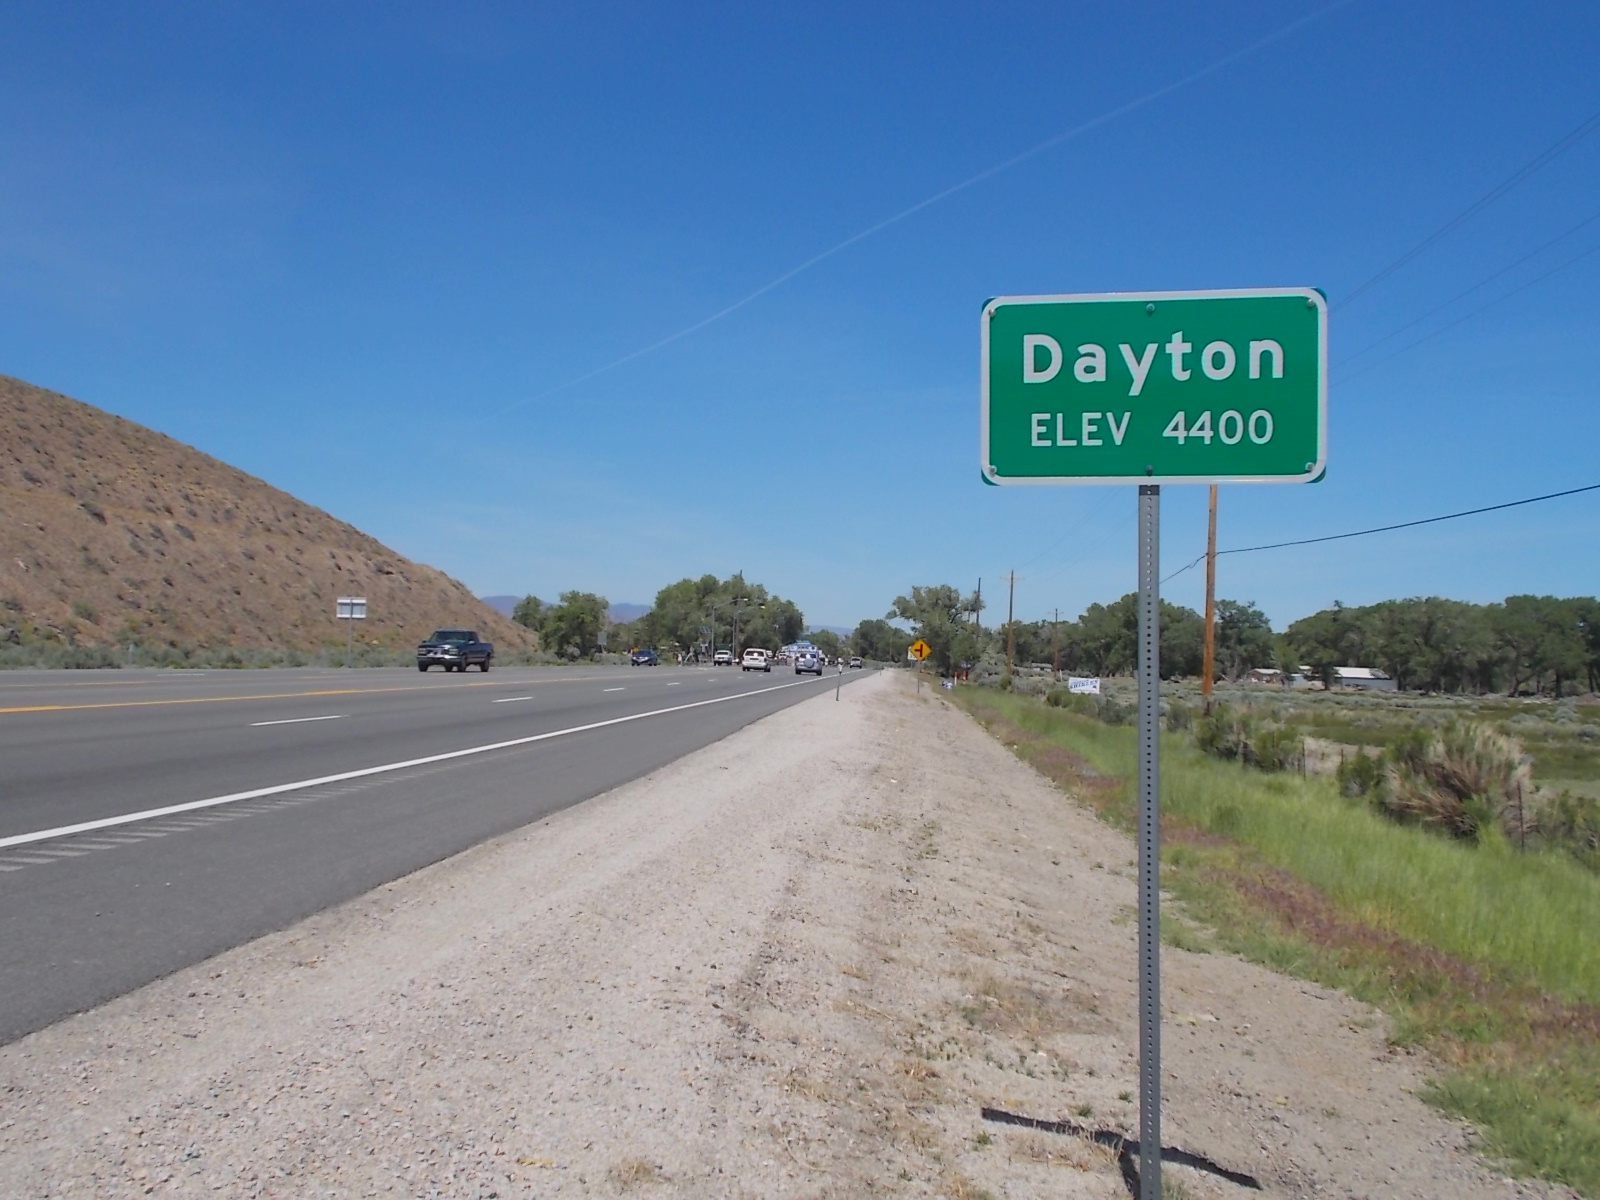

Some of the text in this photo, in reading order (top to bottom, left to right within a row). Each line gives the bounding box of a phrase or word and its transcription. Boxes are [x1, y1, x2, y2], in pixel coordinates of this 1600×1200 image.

[1022, 331, 1284, 396] Dayton
[1031, 409, 1274, 447] ELEV 4400
